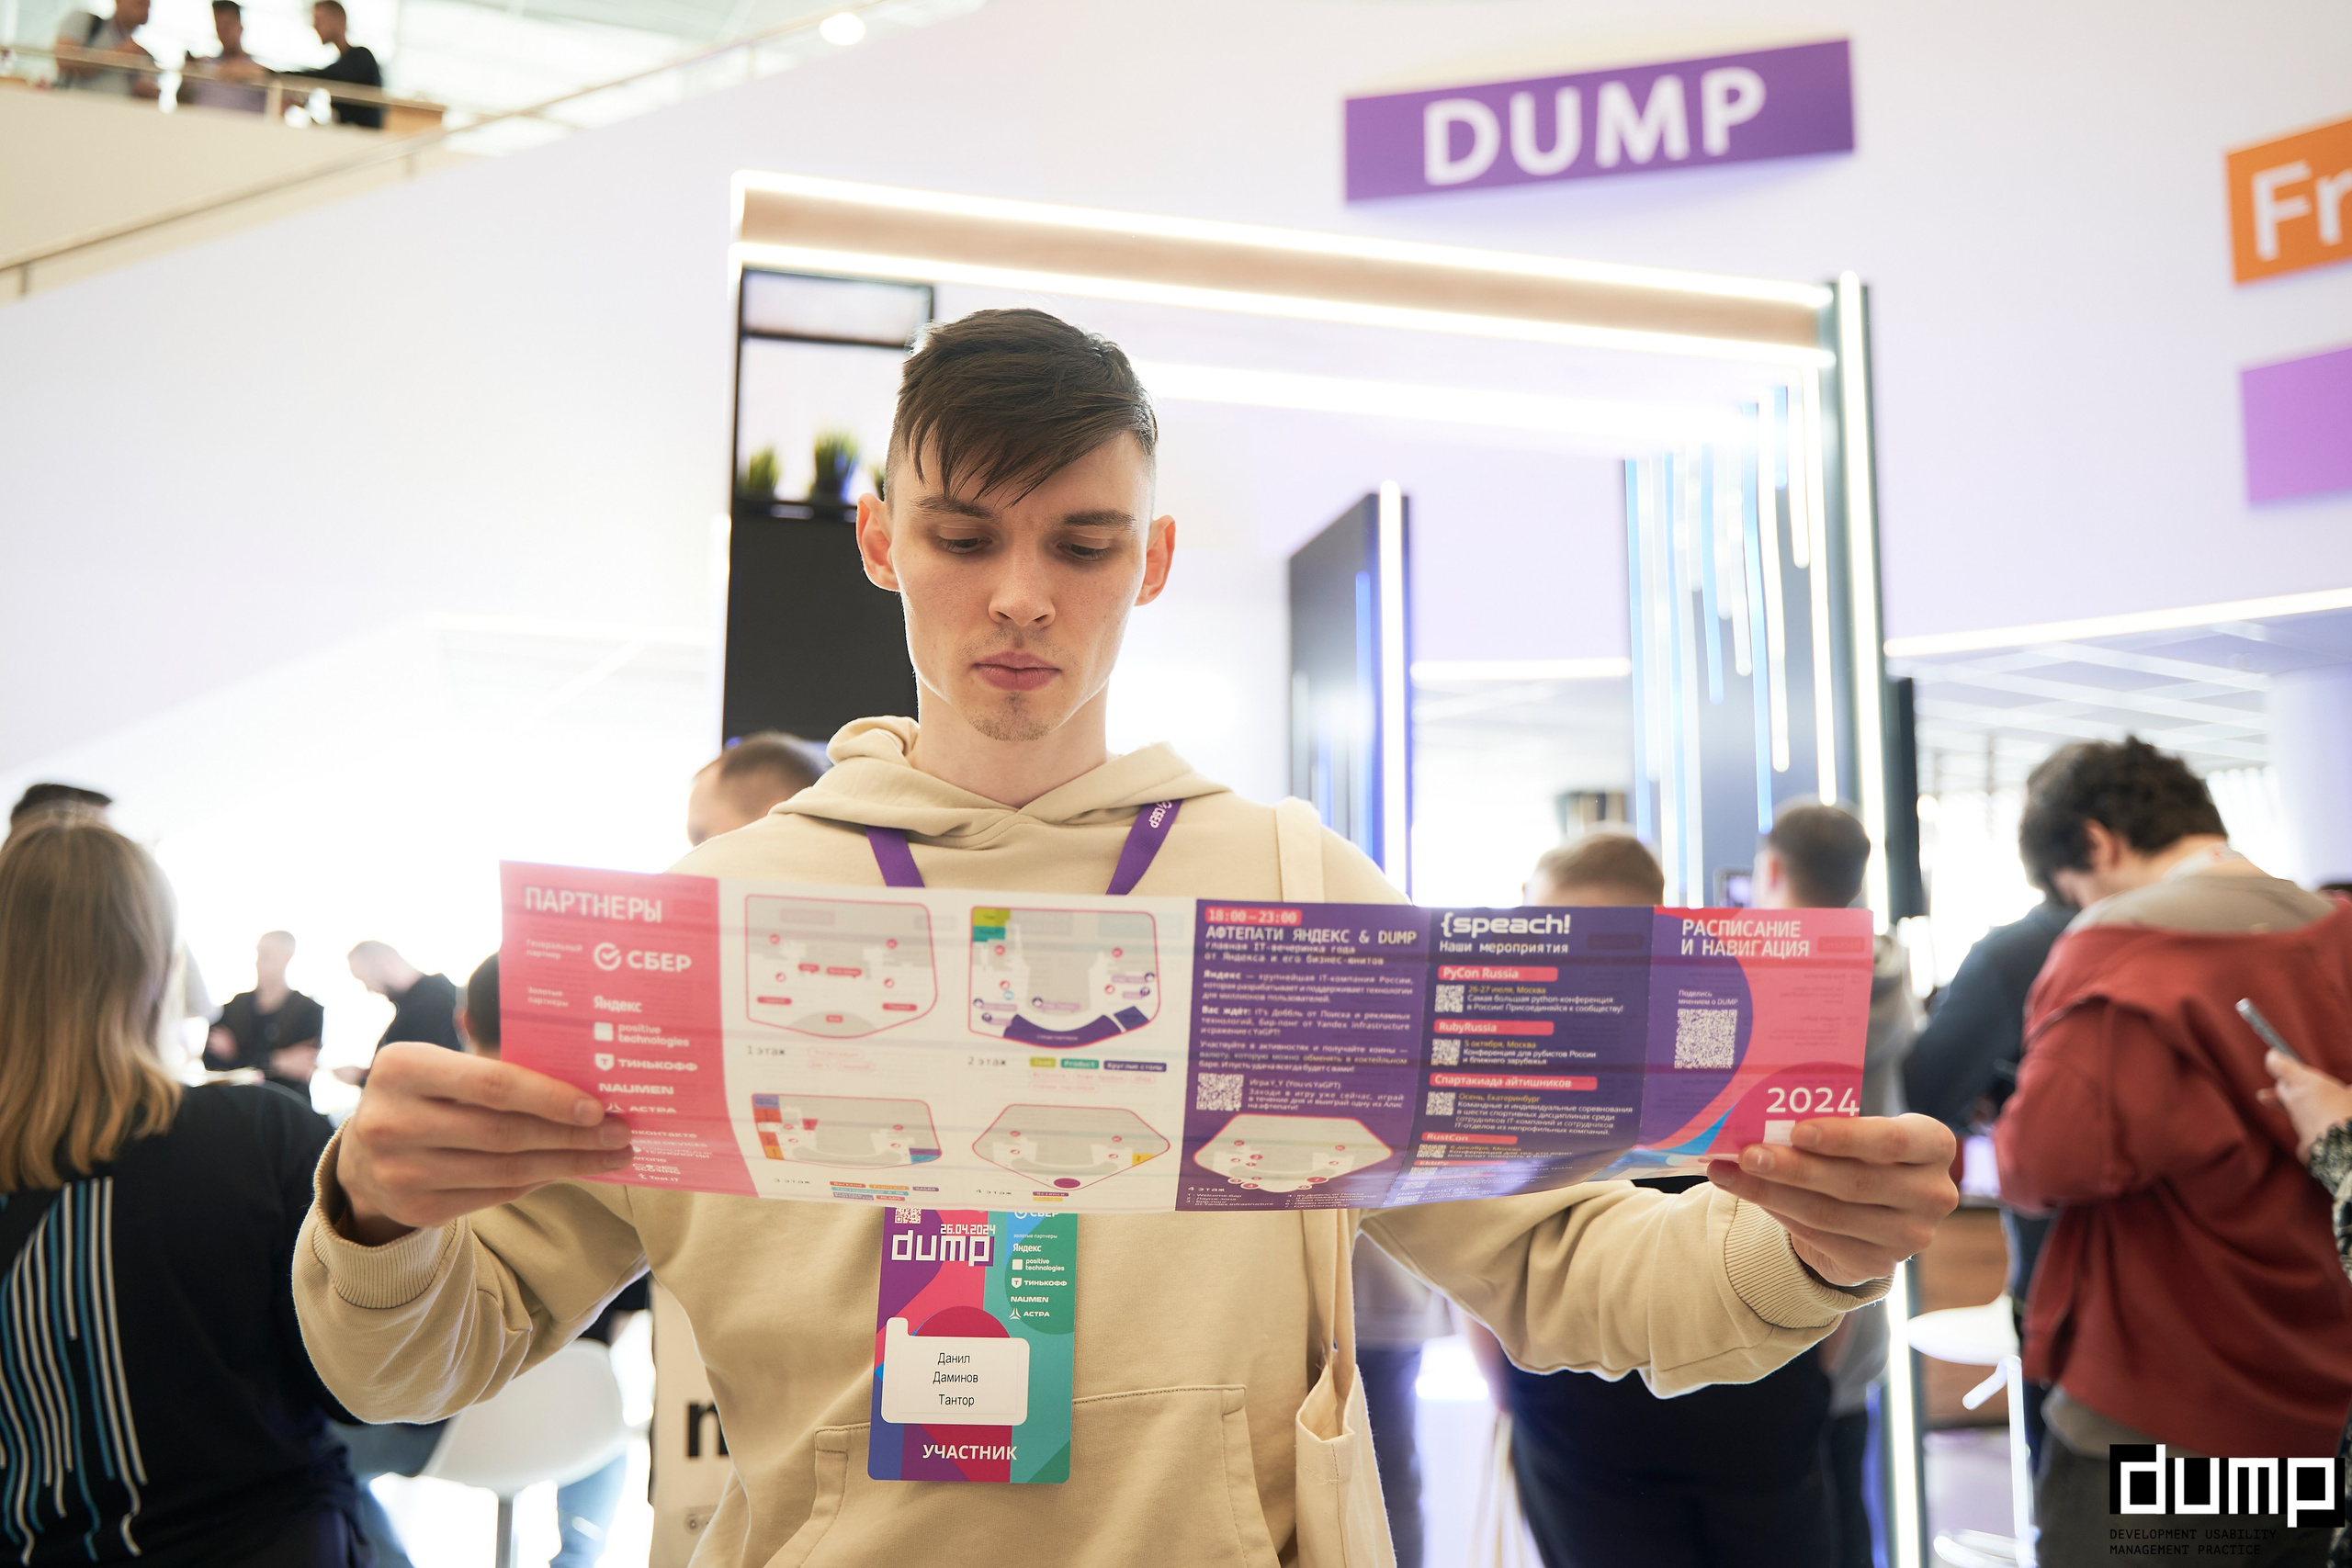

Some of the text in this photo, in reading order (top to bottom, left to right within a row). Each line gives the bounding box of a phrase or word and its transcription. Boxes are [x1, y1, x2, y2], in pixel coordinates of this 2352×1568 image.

[1423, 65, 1767, 186] DUMP
[525, 886, 662, 923] ПАРТНЕРЫ
[1682, 919, 1801, 938] РАСПИСАНИЕ
[1205, 926, 1417, 944] АФТЕПАТИ ЯНДЕКС & DUMP
[526, 939, 583, 953] Генеральный
[1205, 942, 1356, 954] главная IT-вечеринка года
[1439, 940, 1569, 957] Наши мероприятия
[1680, 939, 1810, 960] И НАВИГАЦИЯ
[526, 949, 561, 961] партнер
[1204, 953, 1216, 961] от
[1223, 953, 1266, 963] Яндекса
[1282, 955, 1301, 964] его
[1306, 954, 1384, 965] бизнес-юнитов
[627, 950, 693, 973] СБЕР
[1204, 970, 1413, 986] Яндекс крупнейшая IT-компания России,
[1442, 966, 1519, 981] PyCon Russia
[527, 987, 563, 997] Золотые
[1516, 986, 1546, 995] Москва
[1679, 988, 1713, 998] Поделись
[527, 997, 569, 1008] партнеры
[594, 995, 642, 1013] Яндекс
[1467, 994, 1613, 1006] Самая большая python-конференция
[1717, 998, 1738, 1006] DUMP
[1474, 1002, 1504, 1011] России!
[1506, 1003, 1567, 1013] Присоединяйся
[1575, 1005, 1623, 1015] сообществу!
[618, 1023, 661, 1035] positive
[1317, 1021, 1348, 1029] Yandex
[1439, 1021, 1497, 1034] RubyRussia
[618, 1033, 690, 1048] technologies
[1507, 1041, 1537, 1049] Москва
[757, 1047, 786, 1056] этаж
[1464, 1048, 1597, 1059] Конференция для рубистов России
[618, 1058, 698, 1072] ТИНЬКОФФ
[978, 1058, 1006, 1066] этаж
[1469, 1055, 1505, 1065] ближнего
[1508, 1057, 1547, 1066] зарубежья
[1250, 1078, 1269, 1088] Игра
[1434, 1075, 1572, 1089] Спартакиада айтишников
[598, 1083, 674, 1095] NAUMEN
[1250, 1089, 1281, 1097] Заходи
[1295, 1091, 1315, 1100] игру
[1377, 1092, 1404, 1101] играй
[1458, 1092, 1541, 1104] Осень, Екатеринбург
[1766, 1087, 1860, 1116] 2024
[628, 1105, 677, 1114] АСТРА
[1458, 1101, 1502, 1110] Командные
[1510, 1104, 1577, 1112] индивидуальные
[1578, 1105, 1634, 1114] соревнования
[1489, 1111, 1537, 1119] спортивных
[1538, 1112, 1590, 1121] дисциплинах
[1592, 1114, 1615, 1122] среди
[1455, 1116, 1505, 1124] сотрудников
[1507, 1117, 1555, 1126] IT-компаний
[1564, 1122, 1614, 1130] сотрудников
[1455, 1122, 1495, 1131] IT-отделов
[1508, 1125, 1567, 1134] непрофильных
[1568, 1127, 1610, 1135] компаний.
[1427, 1133, 1468, 1142] RustCon
[941, 1224, 996, 1235] 26.04.2024
[891, 1229, 990, 1267] dump
[1012, 1243, 1043, 1252] Яндекс
[1025, 1258, 1050, 1266] positive
[1025, 1264, 1065, 1273] technologies
[937, 1352, 970, 1366] Данил
[933, 1371, 978, 1384] Даминов
[938, 1393, 975, 1407] Тантор
[922, 1444, 1017, 1461] УЧАСТНИК
